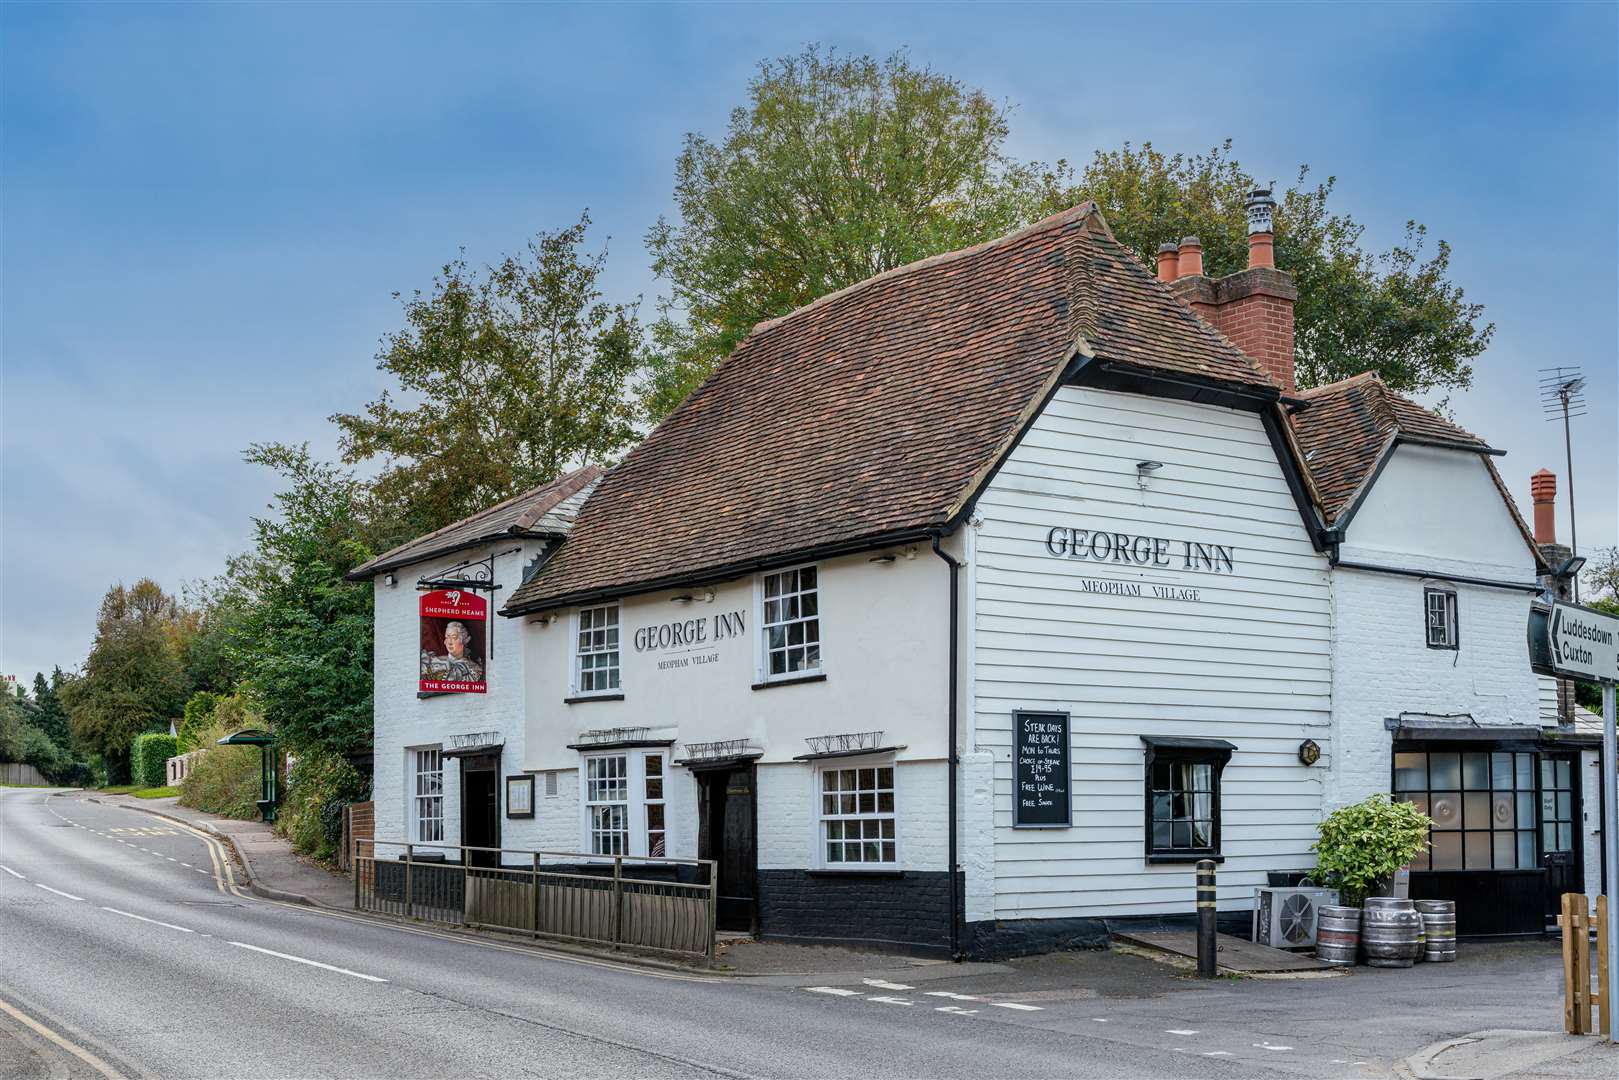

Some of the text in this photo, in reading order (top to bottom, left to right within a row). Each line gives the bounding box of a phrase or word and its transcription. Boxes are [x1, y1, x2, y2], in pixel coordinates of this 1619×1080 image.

[1045, 526, 1235, 573] GEORGE INN
[1081, 579, 1201, 601] MEOPHAM VILLAGE
[425, 606, 460, 615] SHEPHERD
[634, 609, 746, 653] GEORGE INN
[1562, 615, 1613, 646] Luddesdown
[657, 653, 720, 670] MEOPHAM VILLAGE
[1563, 641, 1593, 665] Cuxton
[1027, 734, 1040, 744] ARE
